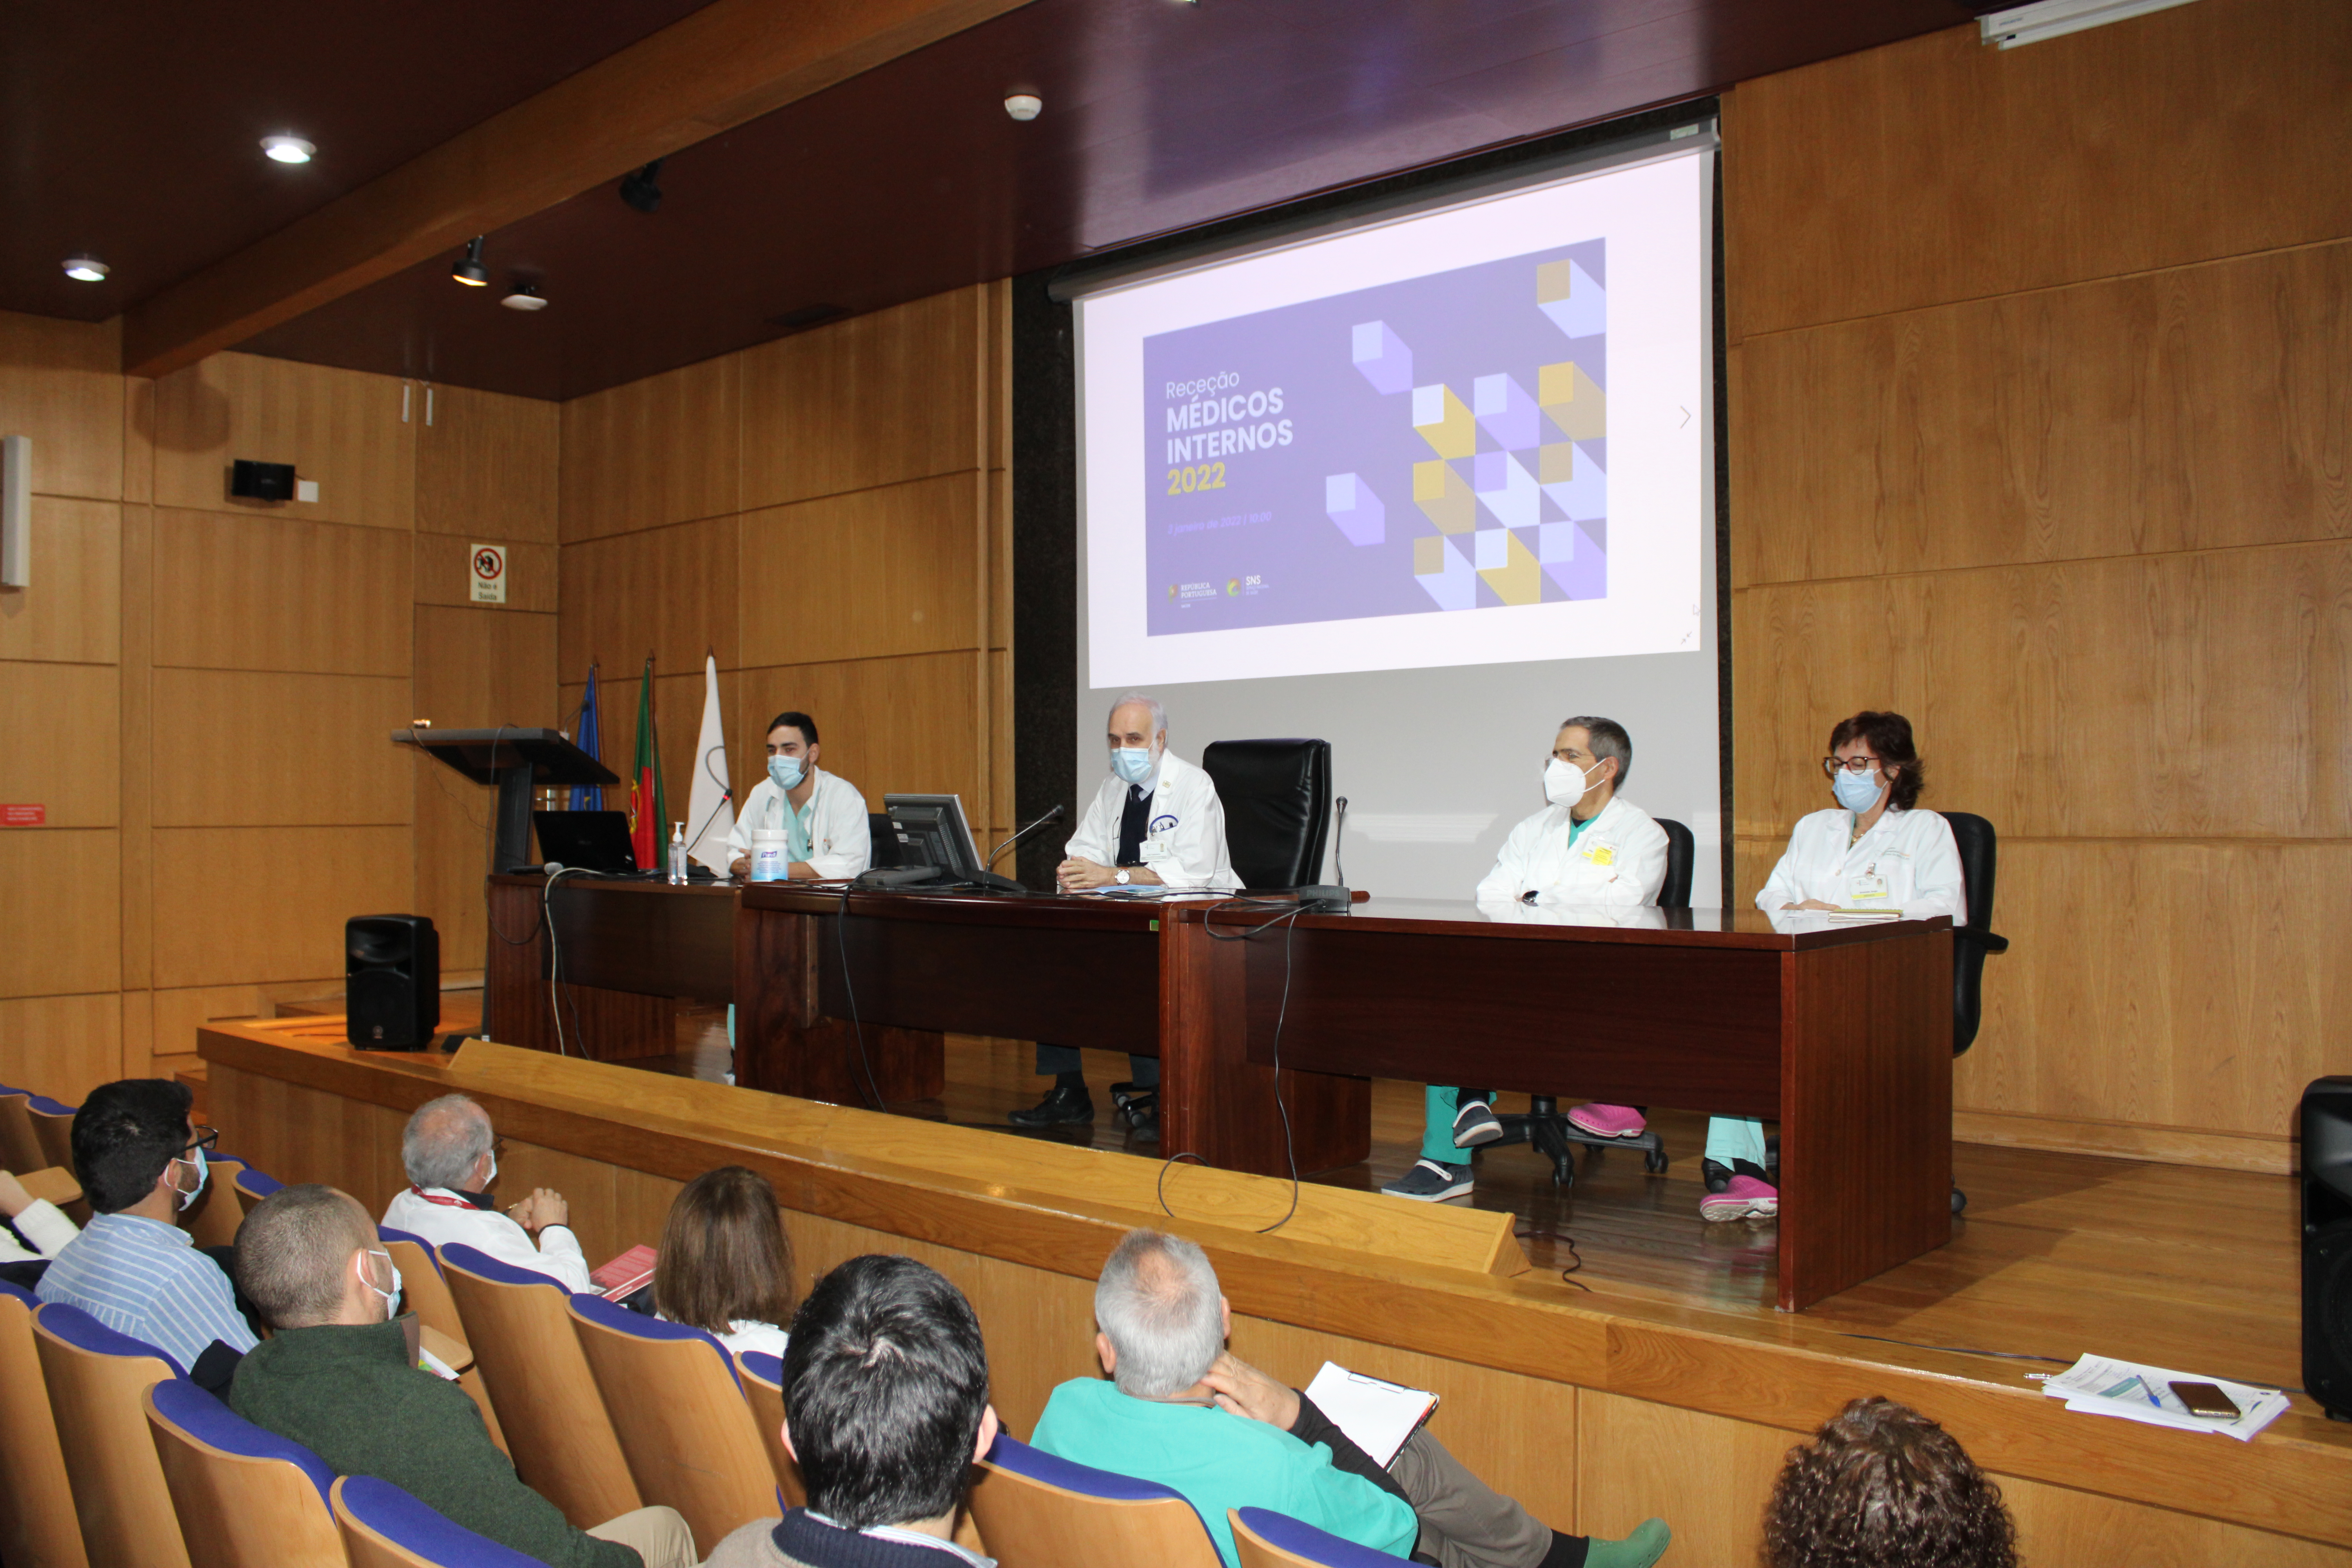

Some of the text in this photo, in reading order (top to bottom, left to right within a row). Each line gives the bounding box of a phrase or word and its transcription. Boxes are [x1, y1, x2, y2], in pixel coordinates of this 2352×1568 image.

[1166, 371, 1239, 399] Receção
[1167, 387, 1284, 432] MÉDICOS
[1167, 419, 1293, 465] INTERNOS
[1167, 462, 1226, 495] 2022
[1174, 522, 1205, 536] janeiro
[1207, 520, 1218, 529] de
[1220, 515, 1241, 527] 2022
[1249, 511, 1272, 523] 10:00
[1181, 582, 1210, 591] REPÚBLICA
[1246, 575, 1261, 586] SNS
[1181, 589, 1217, 599] PORTUGUESA
[1307, 889, 1340, 897] PHILIPS
